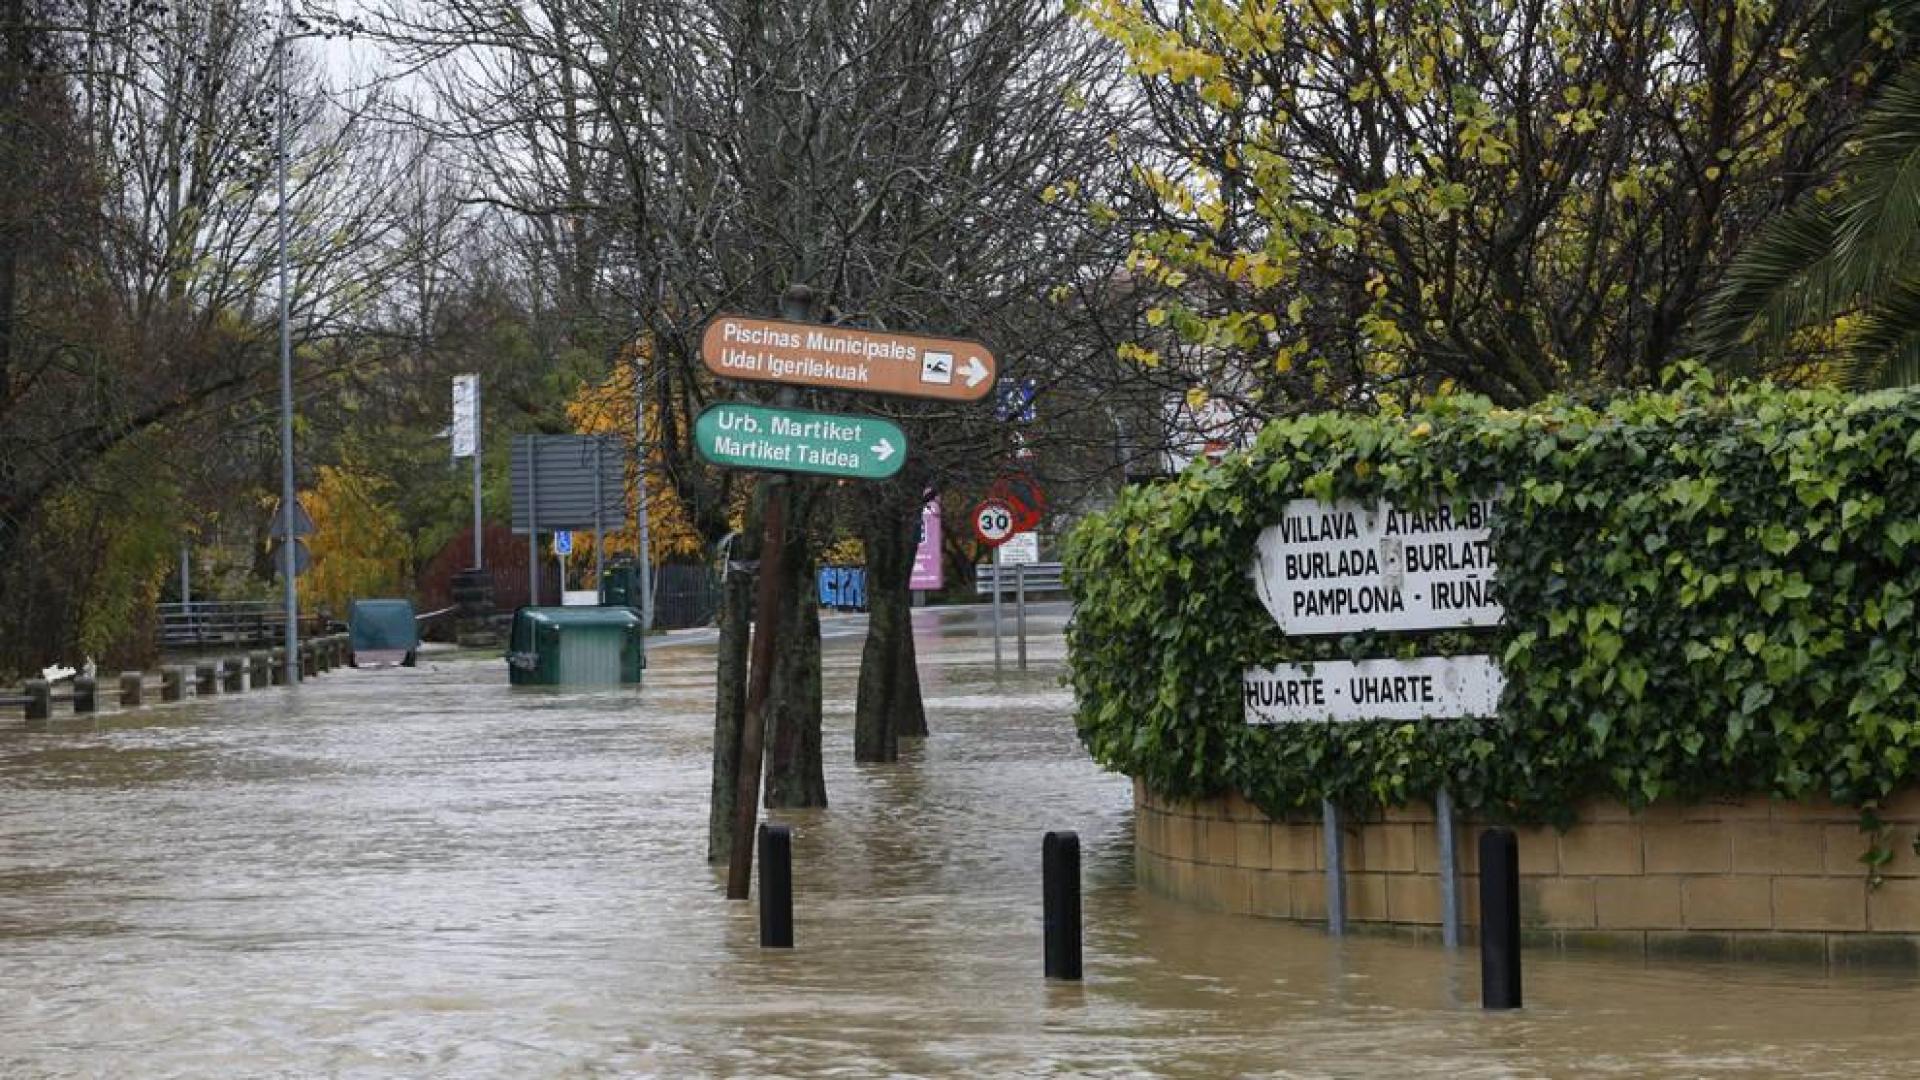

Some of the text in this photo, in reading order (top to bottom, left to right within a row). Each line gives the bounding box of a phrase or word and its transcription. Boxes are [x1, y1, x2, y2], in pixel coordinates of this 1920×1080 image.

[723, 323, 916, 361] Piscinas Municipales
[721, 348, 868, 382] Udal Igerilekuak
[718, 410, 862, 442] Urb. Martiket
[714, 436, 860, 468] Martiket Taldea
[980, 515, 1008, 530] 30
[1281, 511, 1359, 544] VILLAVA
[1286, 548, 1380, 580] BURLADA
[1293, 585, 1404, 618] PAMPLONA
[1246, 679, 1325, 706] HUARTE
[1350, 676, 1433, 704] UHARTE
